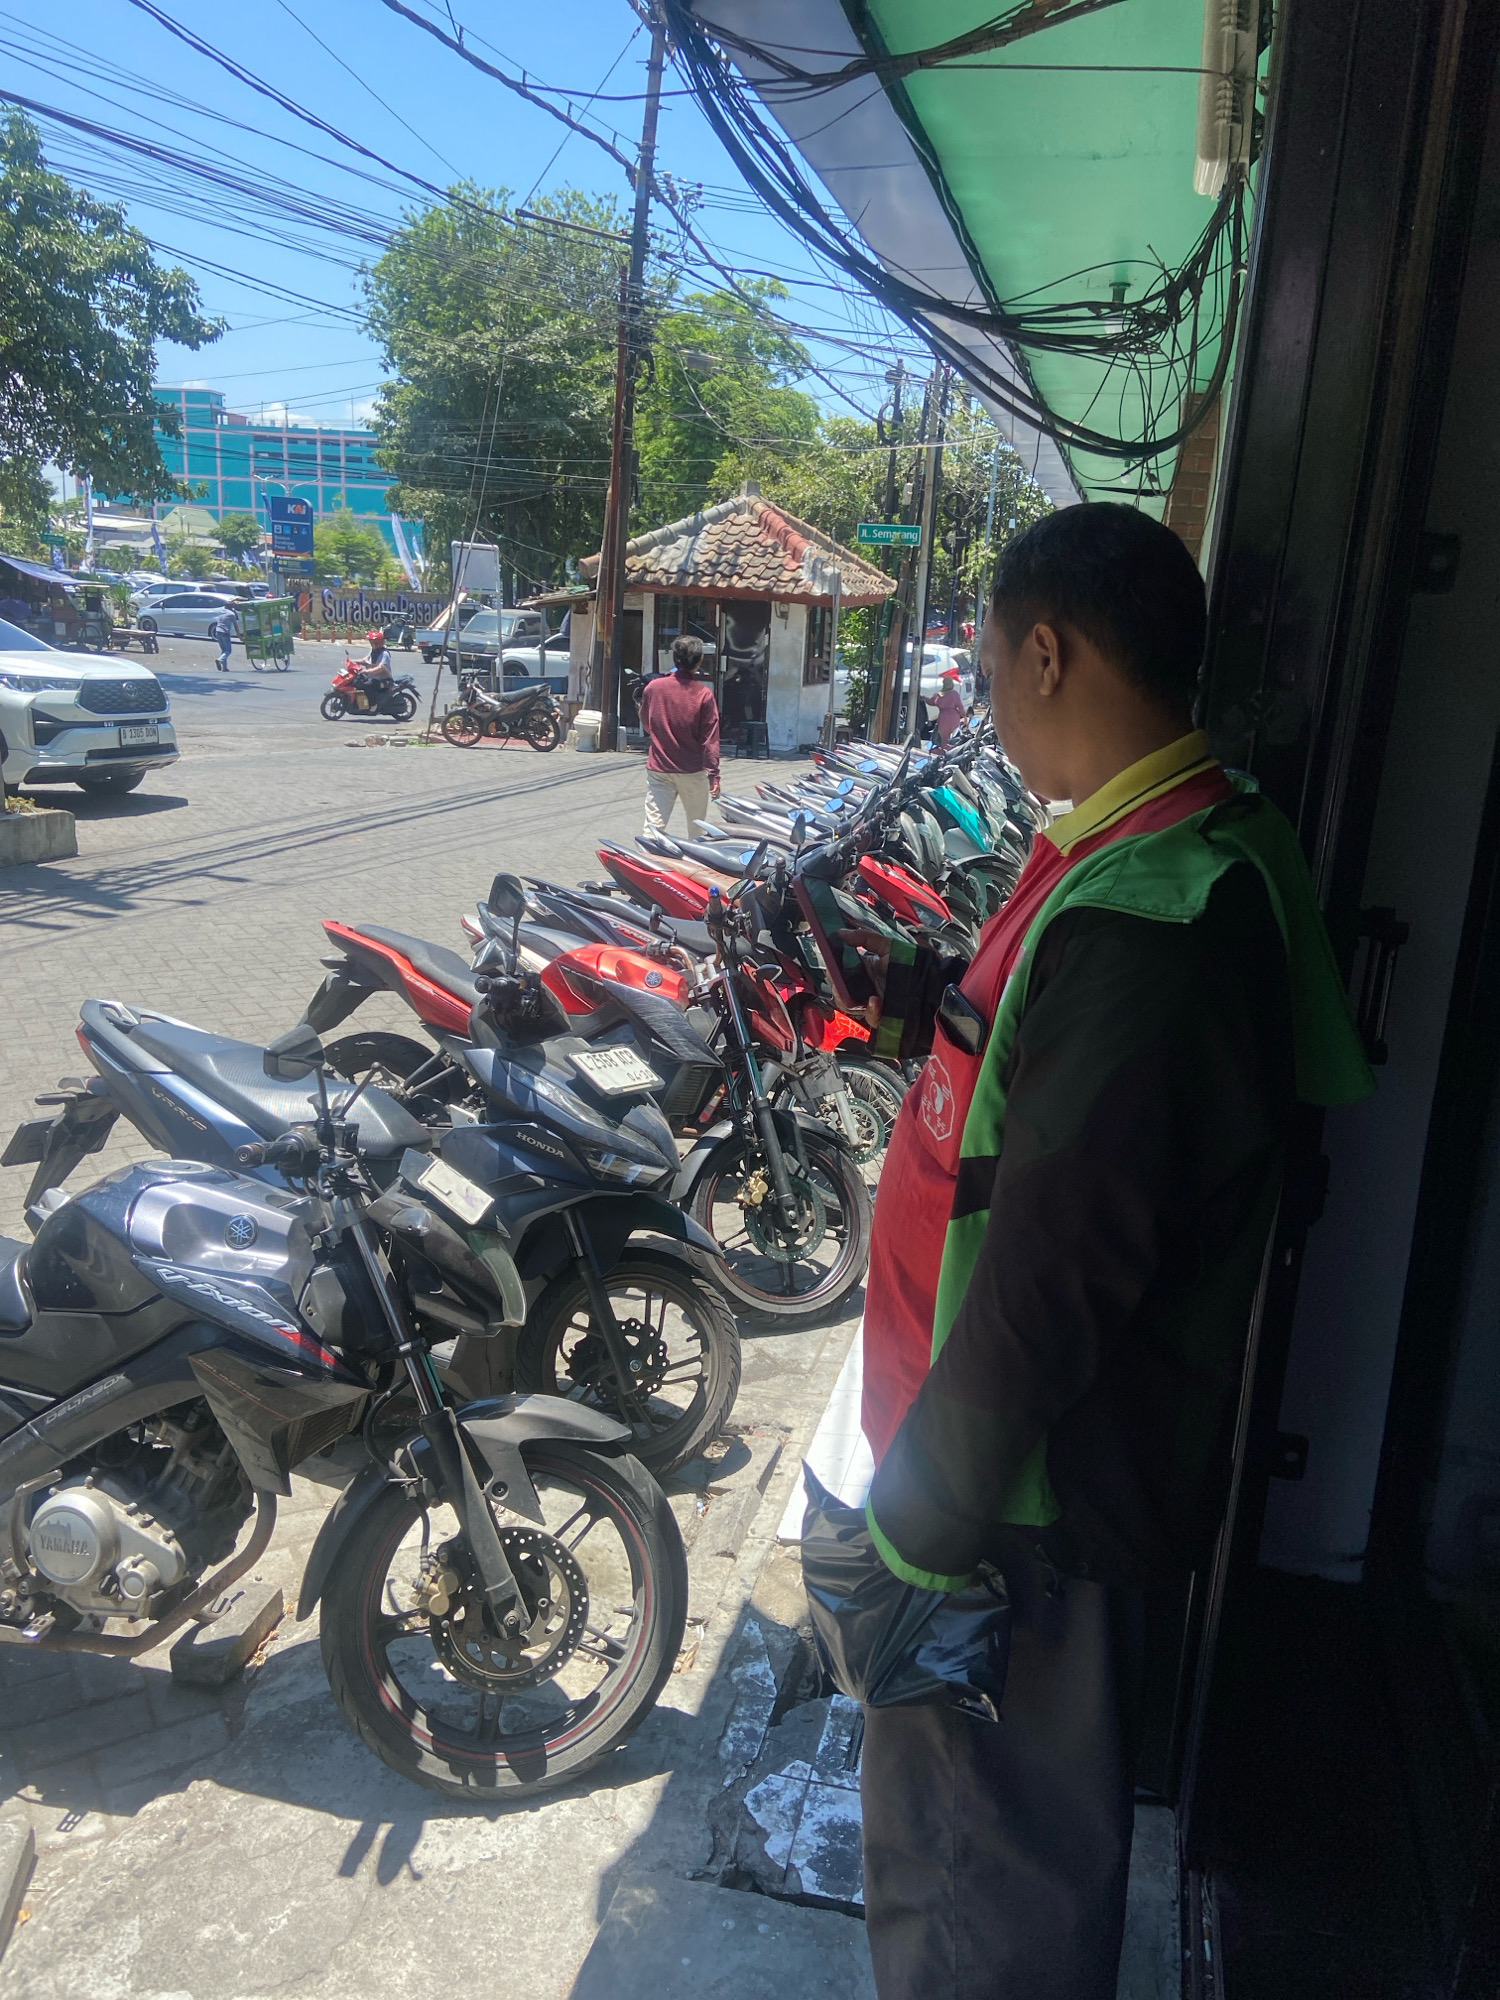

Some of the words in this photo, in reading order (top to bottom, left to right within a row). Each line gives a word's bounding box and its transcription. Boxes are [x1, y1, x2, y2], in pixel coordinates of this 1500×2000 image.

[122, 729, 127, 739] B
[516, 1130, 565, 1159] HONDA
[46, 1371, 126, 1424] DELTABOX
[40, 1534, 91, 1556] YAMAHA
